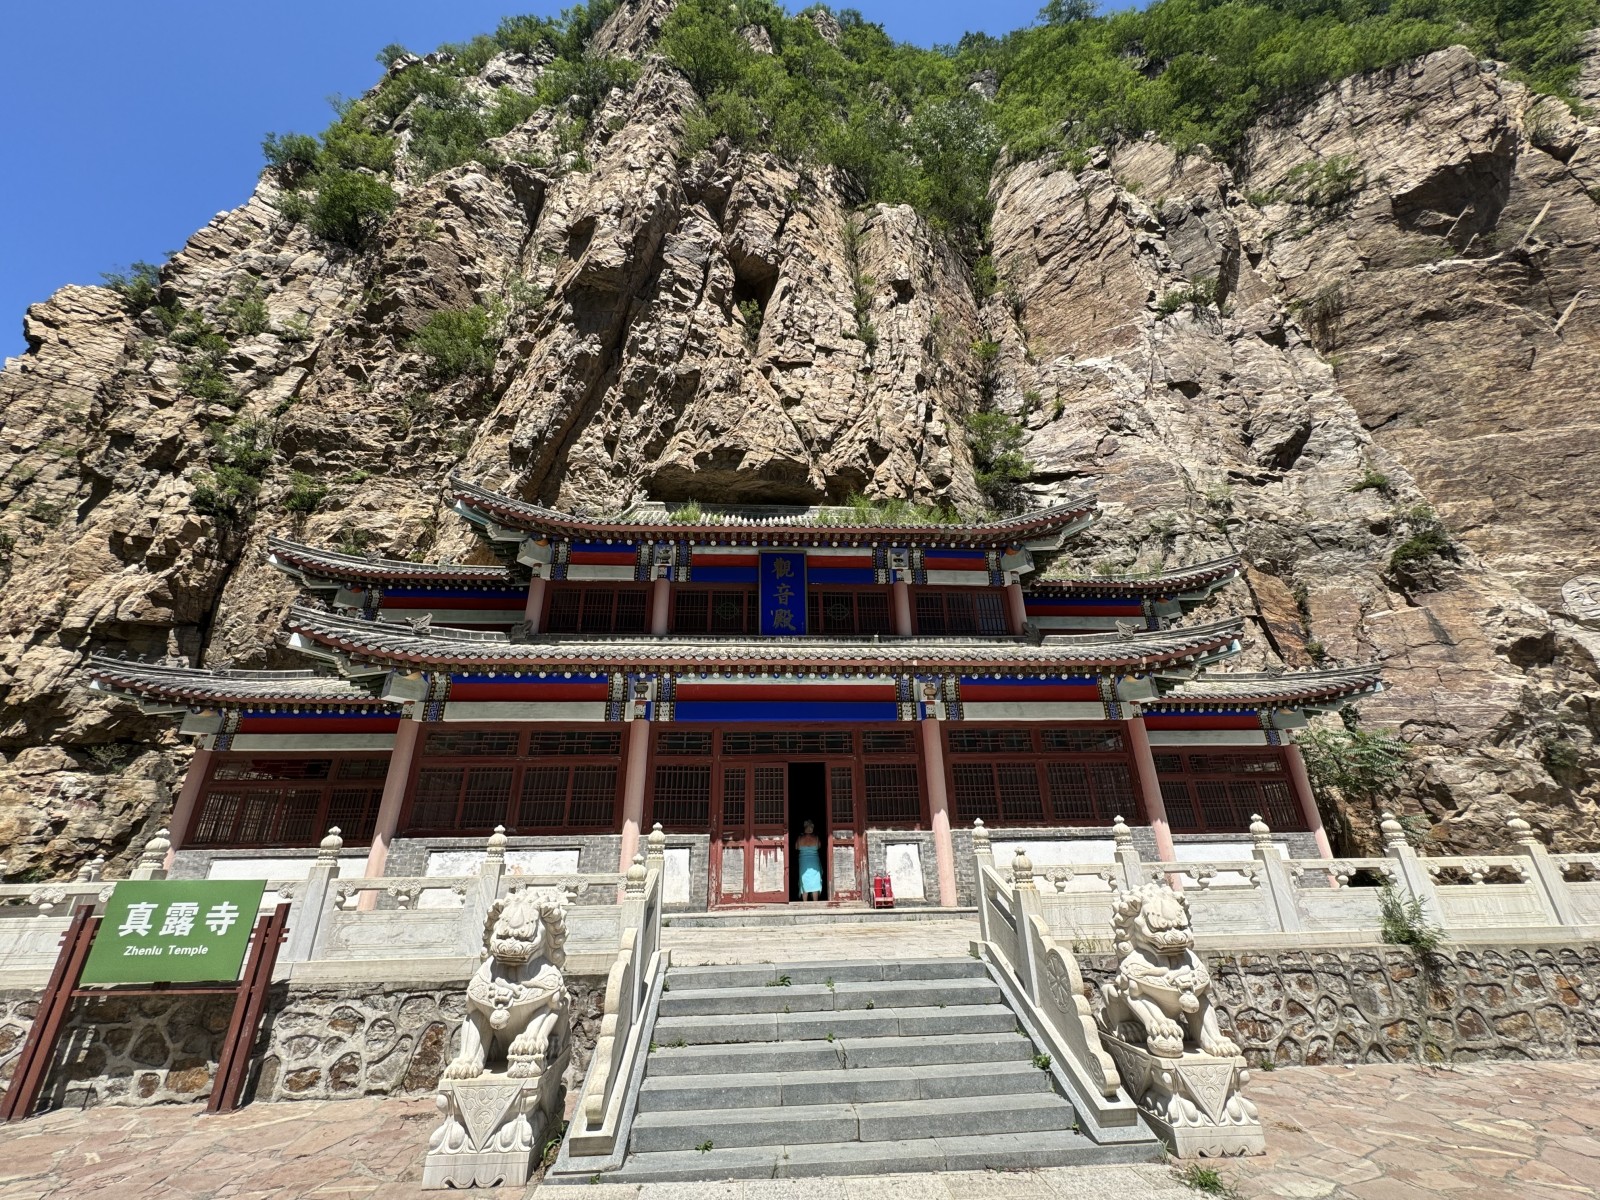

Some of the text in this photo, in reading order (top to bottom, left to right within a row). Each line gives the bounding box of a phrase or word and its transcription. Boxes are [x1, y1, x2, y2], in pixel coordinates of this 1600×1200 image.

[771, 557, 796, 631] 觀音殿
[118, 901, 240, 937] 真露寺
[123, 945, 208, 957] Zhenlu Temple
